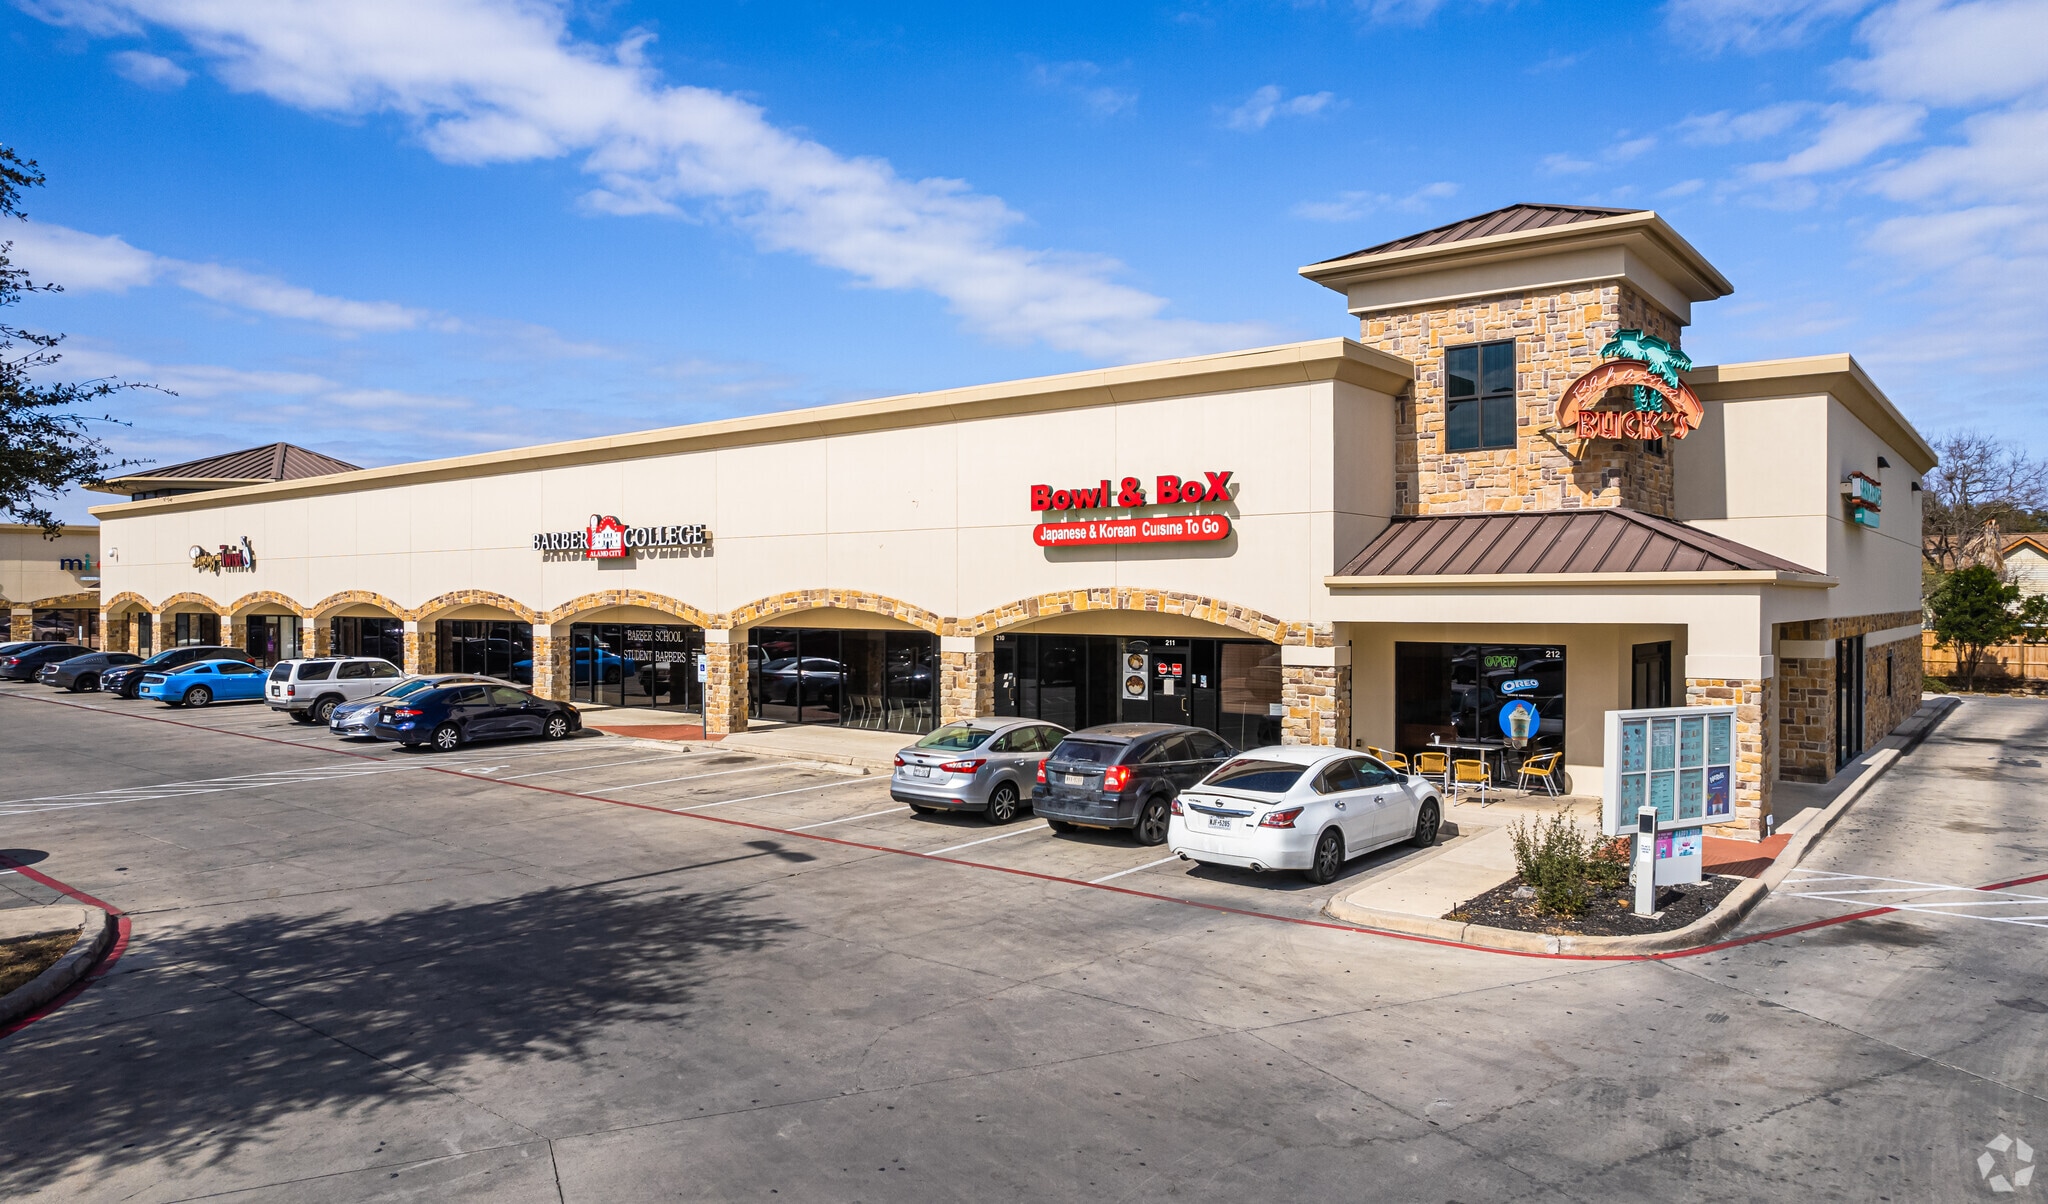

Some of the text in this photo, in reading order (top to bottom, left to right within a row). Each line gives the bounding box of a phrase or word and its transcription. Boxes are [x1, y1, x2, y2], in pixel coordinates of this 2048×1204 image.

[1577, 410, 1689, 440] BUCK'S
[1031, 480, 1111, 511] Bowl
[1118, 477, 1146, 508] &
[1040, 518, 1219, 543] Japanese & Korean Cuisine To Go
[532, 525, 706, 551] BARBER COLLEGE
[627, 630, 683, 643] BARBER SCHOOL
[624, 649, 652, 661] STUDENT
[655, 651, 686, 663] BARBERS
[1545, 650, 1561, 658] 212
[1484, 655, 1518, 668] OPEN
[1502, 679, 1539, 692] OREO
